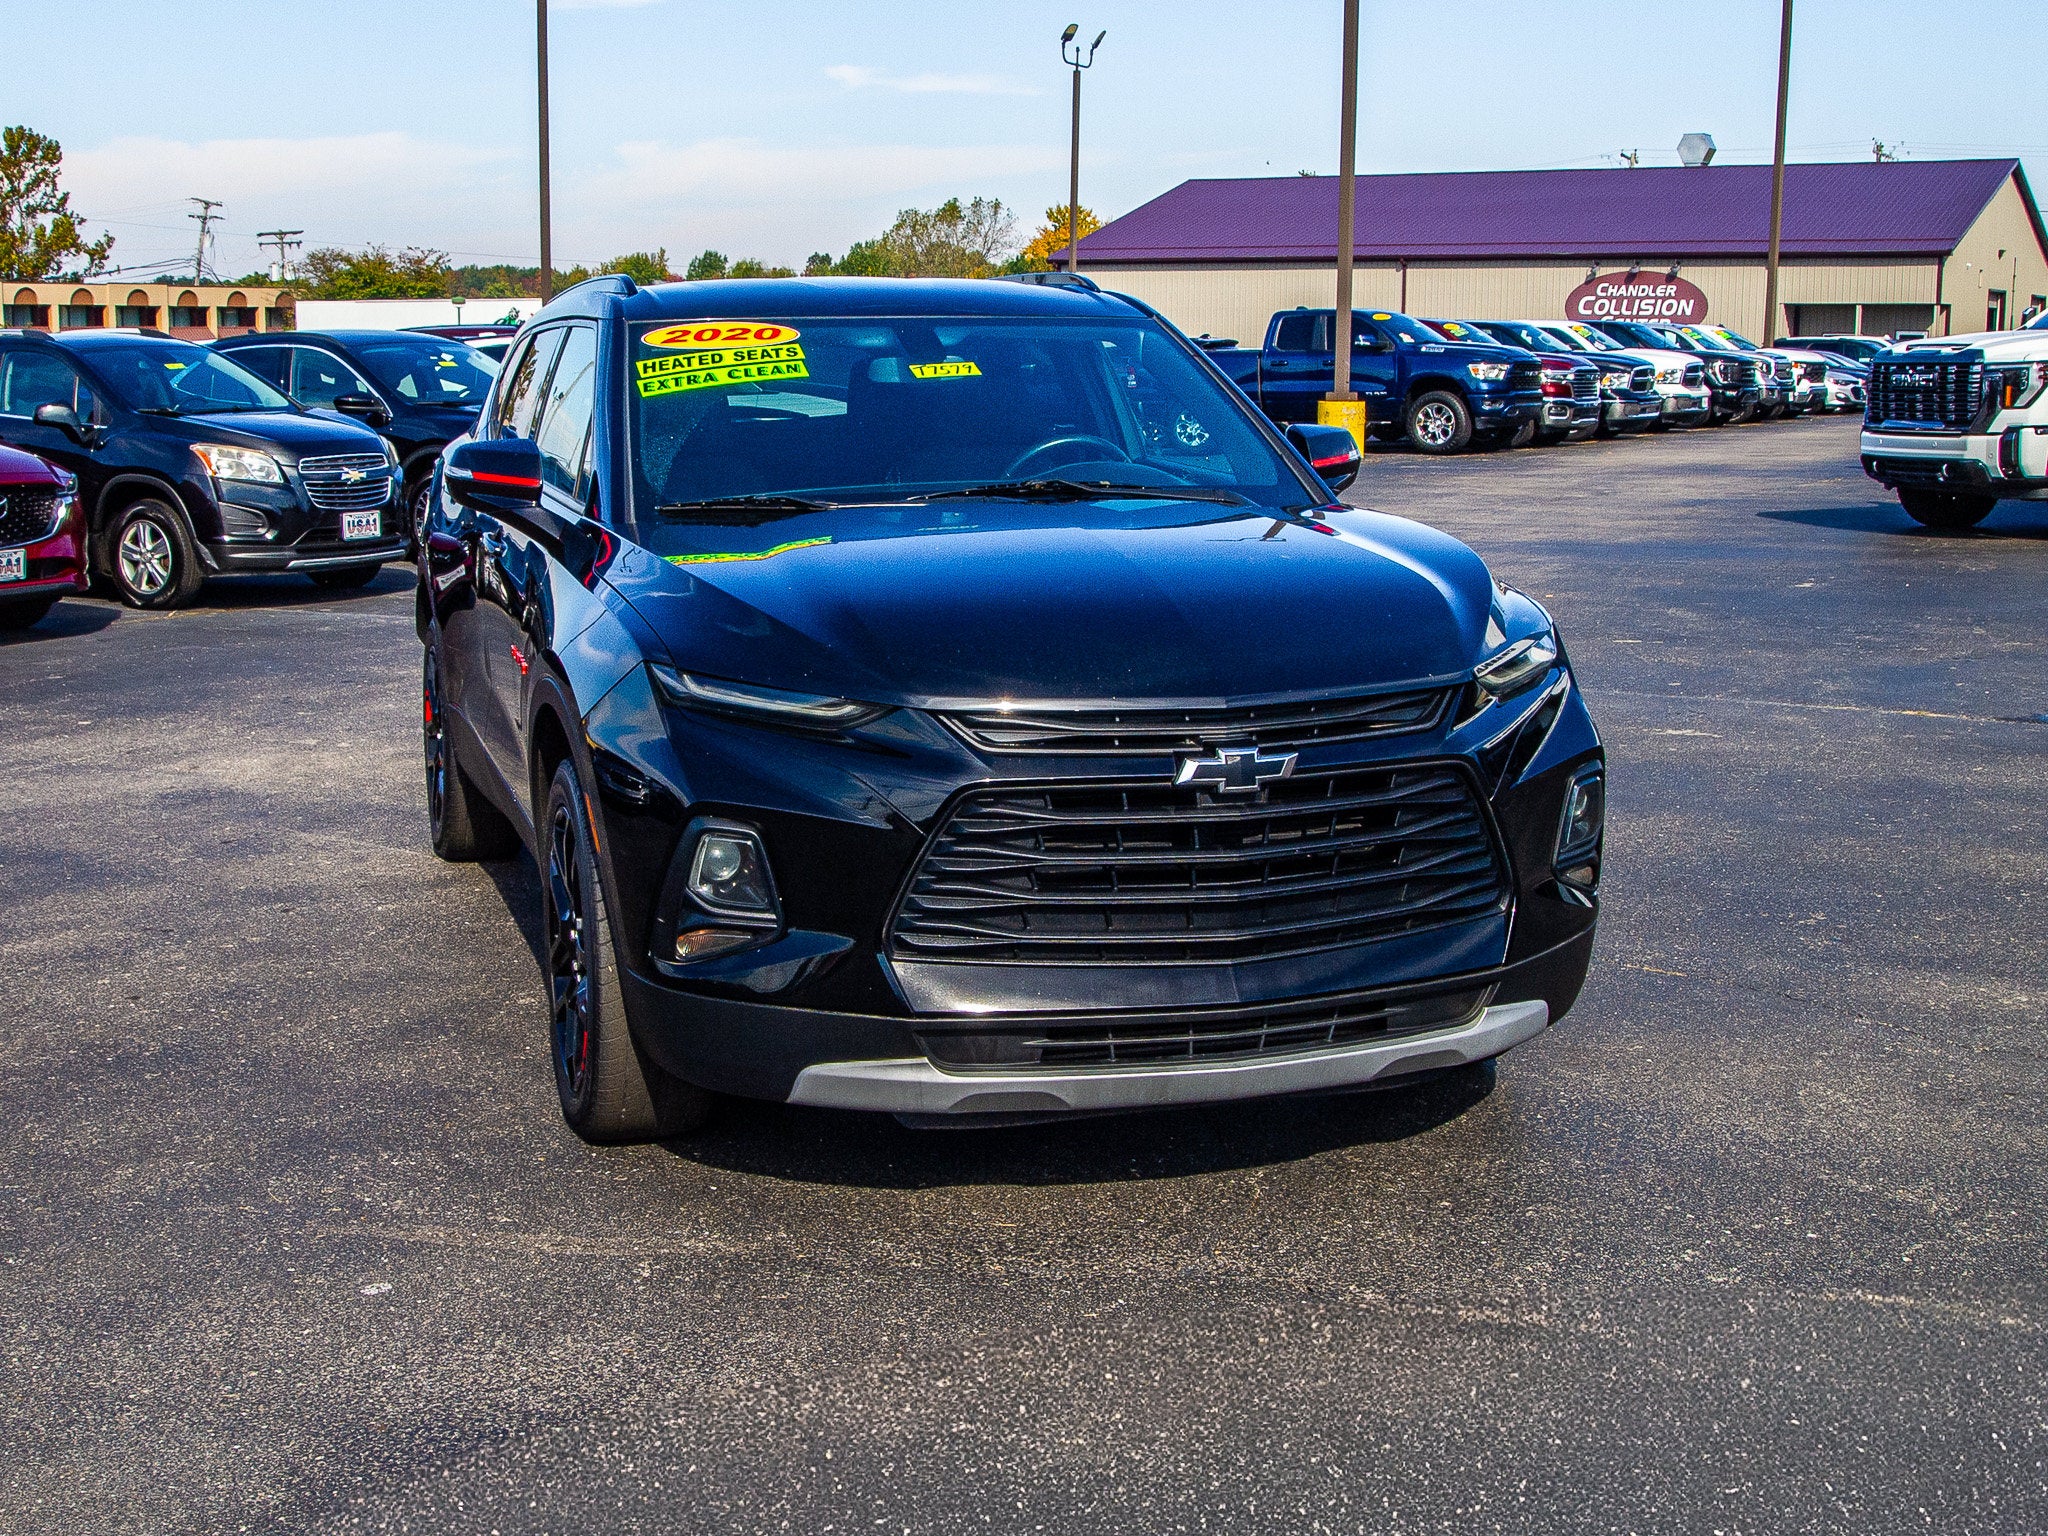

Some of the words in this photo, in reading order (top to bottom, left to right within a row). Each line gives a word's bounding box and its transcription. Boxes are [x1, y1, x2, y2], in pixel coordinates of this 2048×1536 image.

[1596, 282, 1677, 297] CHANDLER
[1577, 296, 1695, 316] COLLISION
[660, 327, 782, 344] 2020
[642, 353, 724, 375] HEATED
[733, 347, 799, 362] SEATS
[642, 372, 718, 393] EXTRA
[727, 363, 801, 379] CLEAN
[1891, 373, 1933, 387] GMC
[347, 517, 377, 534] USA1
